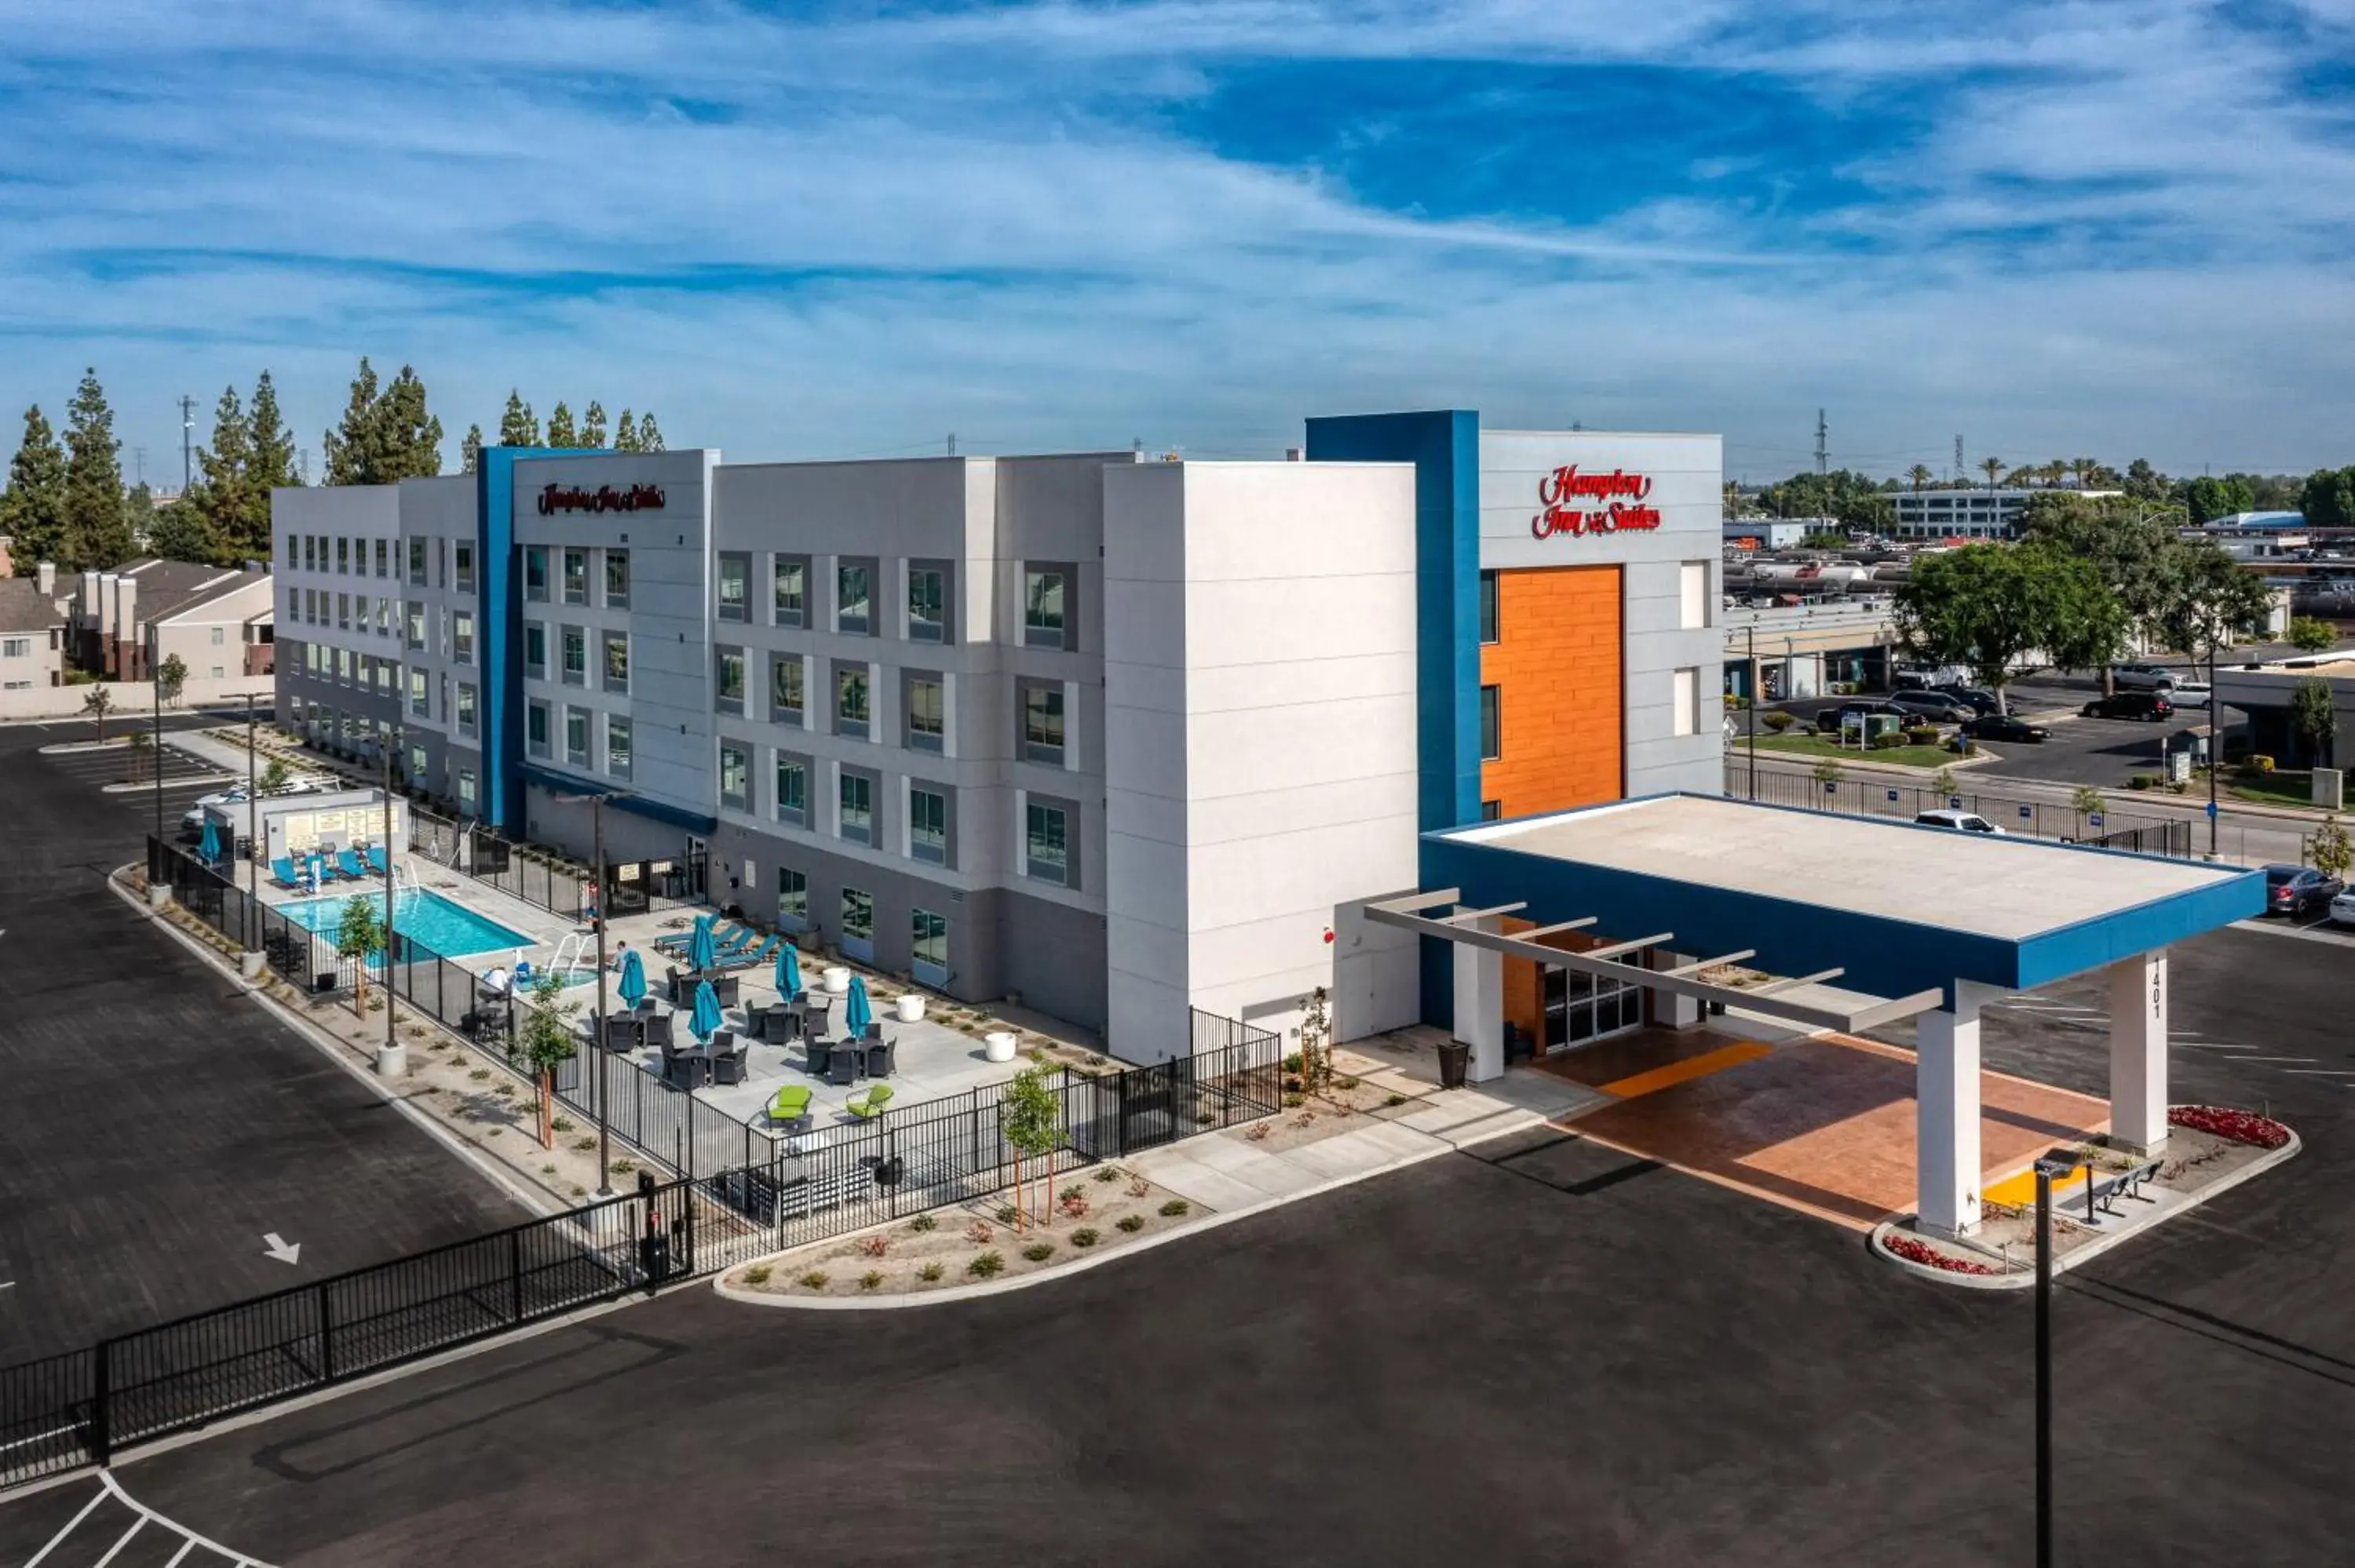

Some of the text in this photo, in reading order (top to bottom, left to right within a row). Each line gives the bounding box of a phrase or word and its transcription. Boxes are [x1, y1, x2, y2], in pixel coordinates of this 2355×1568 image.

[1539, 464, 1652, 506] Hampton
[1532, 505, 1590, 540] Inn
[1604, 501, 1661, 532] Suites
